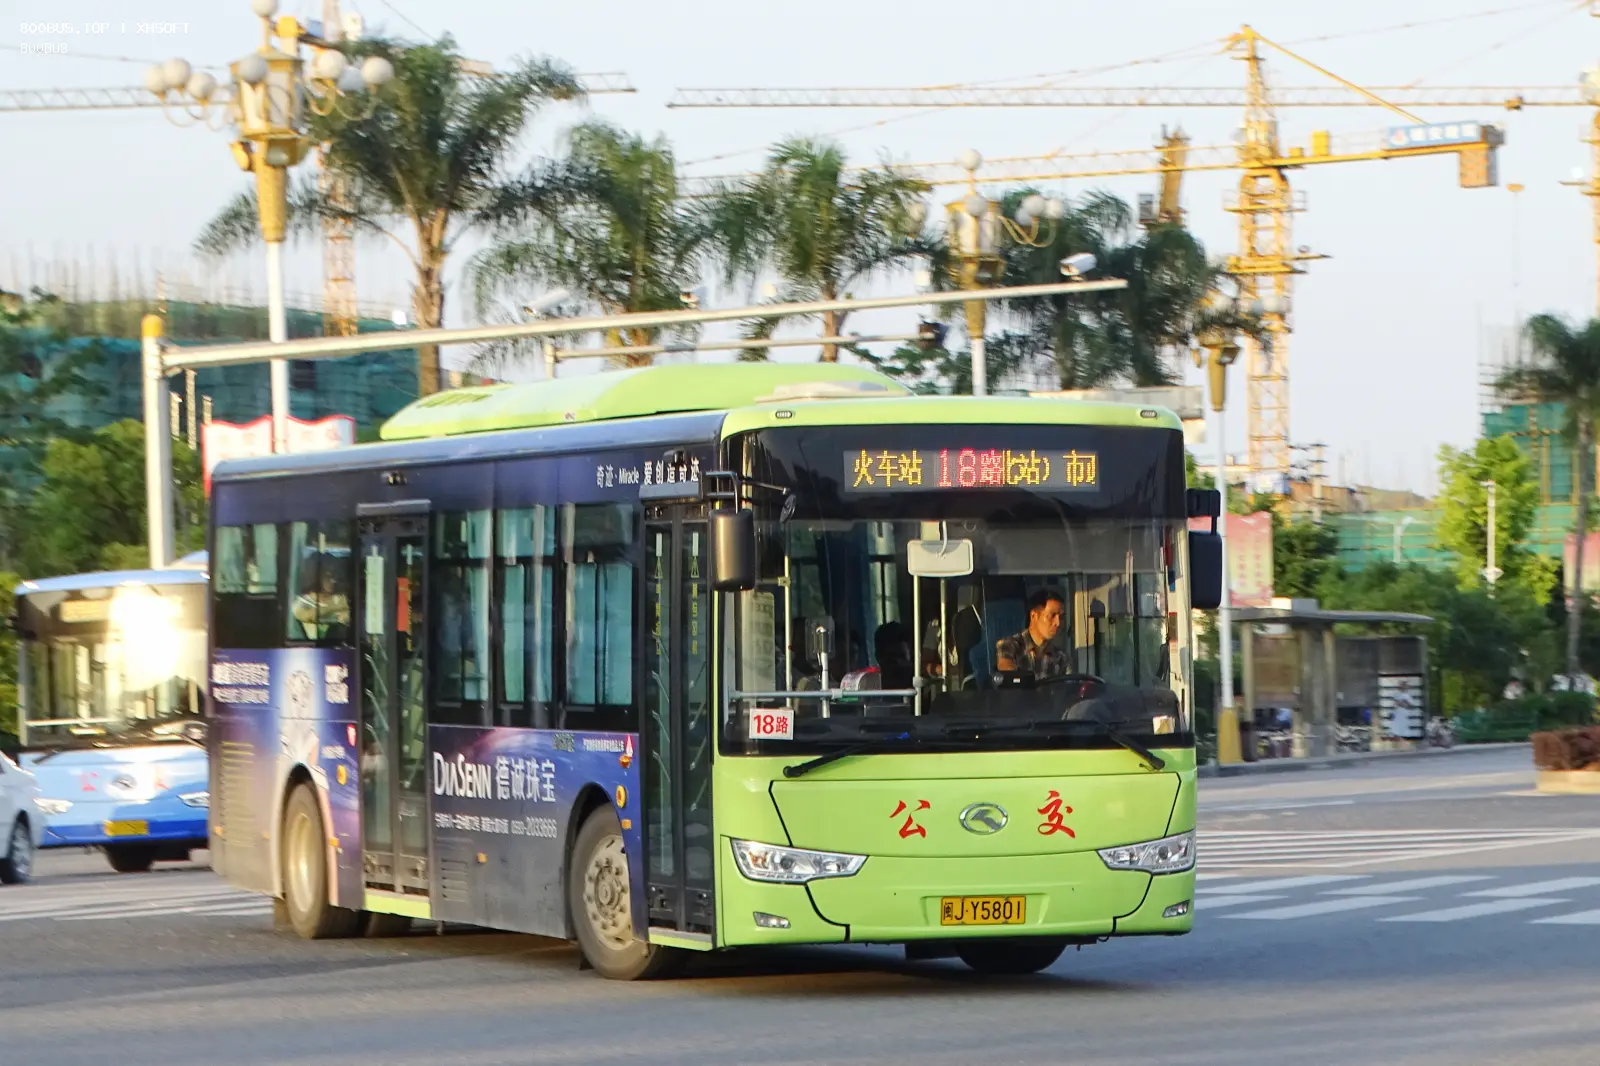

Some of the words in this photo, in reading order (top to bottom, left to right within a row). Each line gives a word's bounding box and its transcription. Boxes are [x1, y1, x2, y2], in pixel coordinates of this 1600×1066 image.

[853, 449, 922, 487] 火车站
[753, 714, 789, 735] 18路
[495, 755, 556, 803] 德诚珠宝
[889, 799, 931, 839] 公
[1037, 790, 1076, 839] 交
